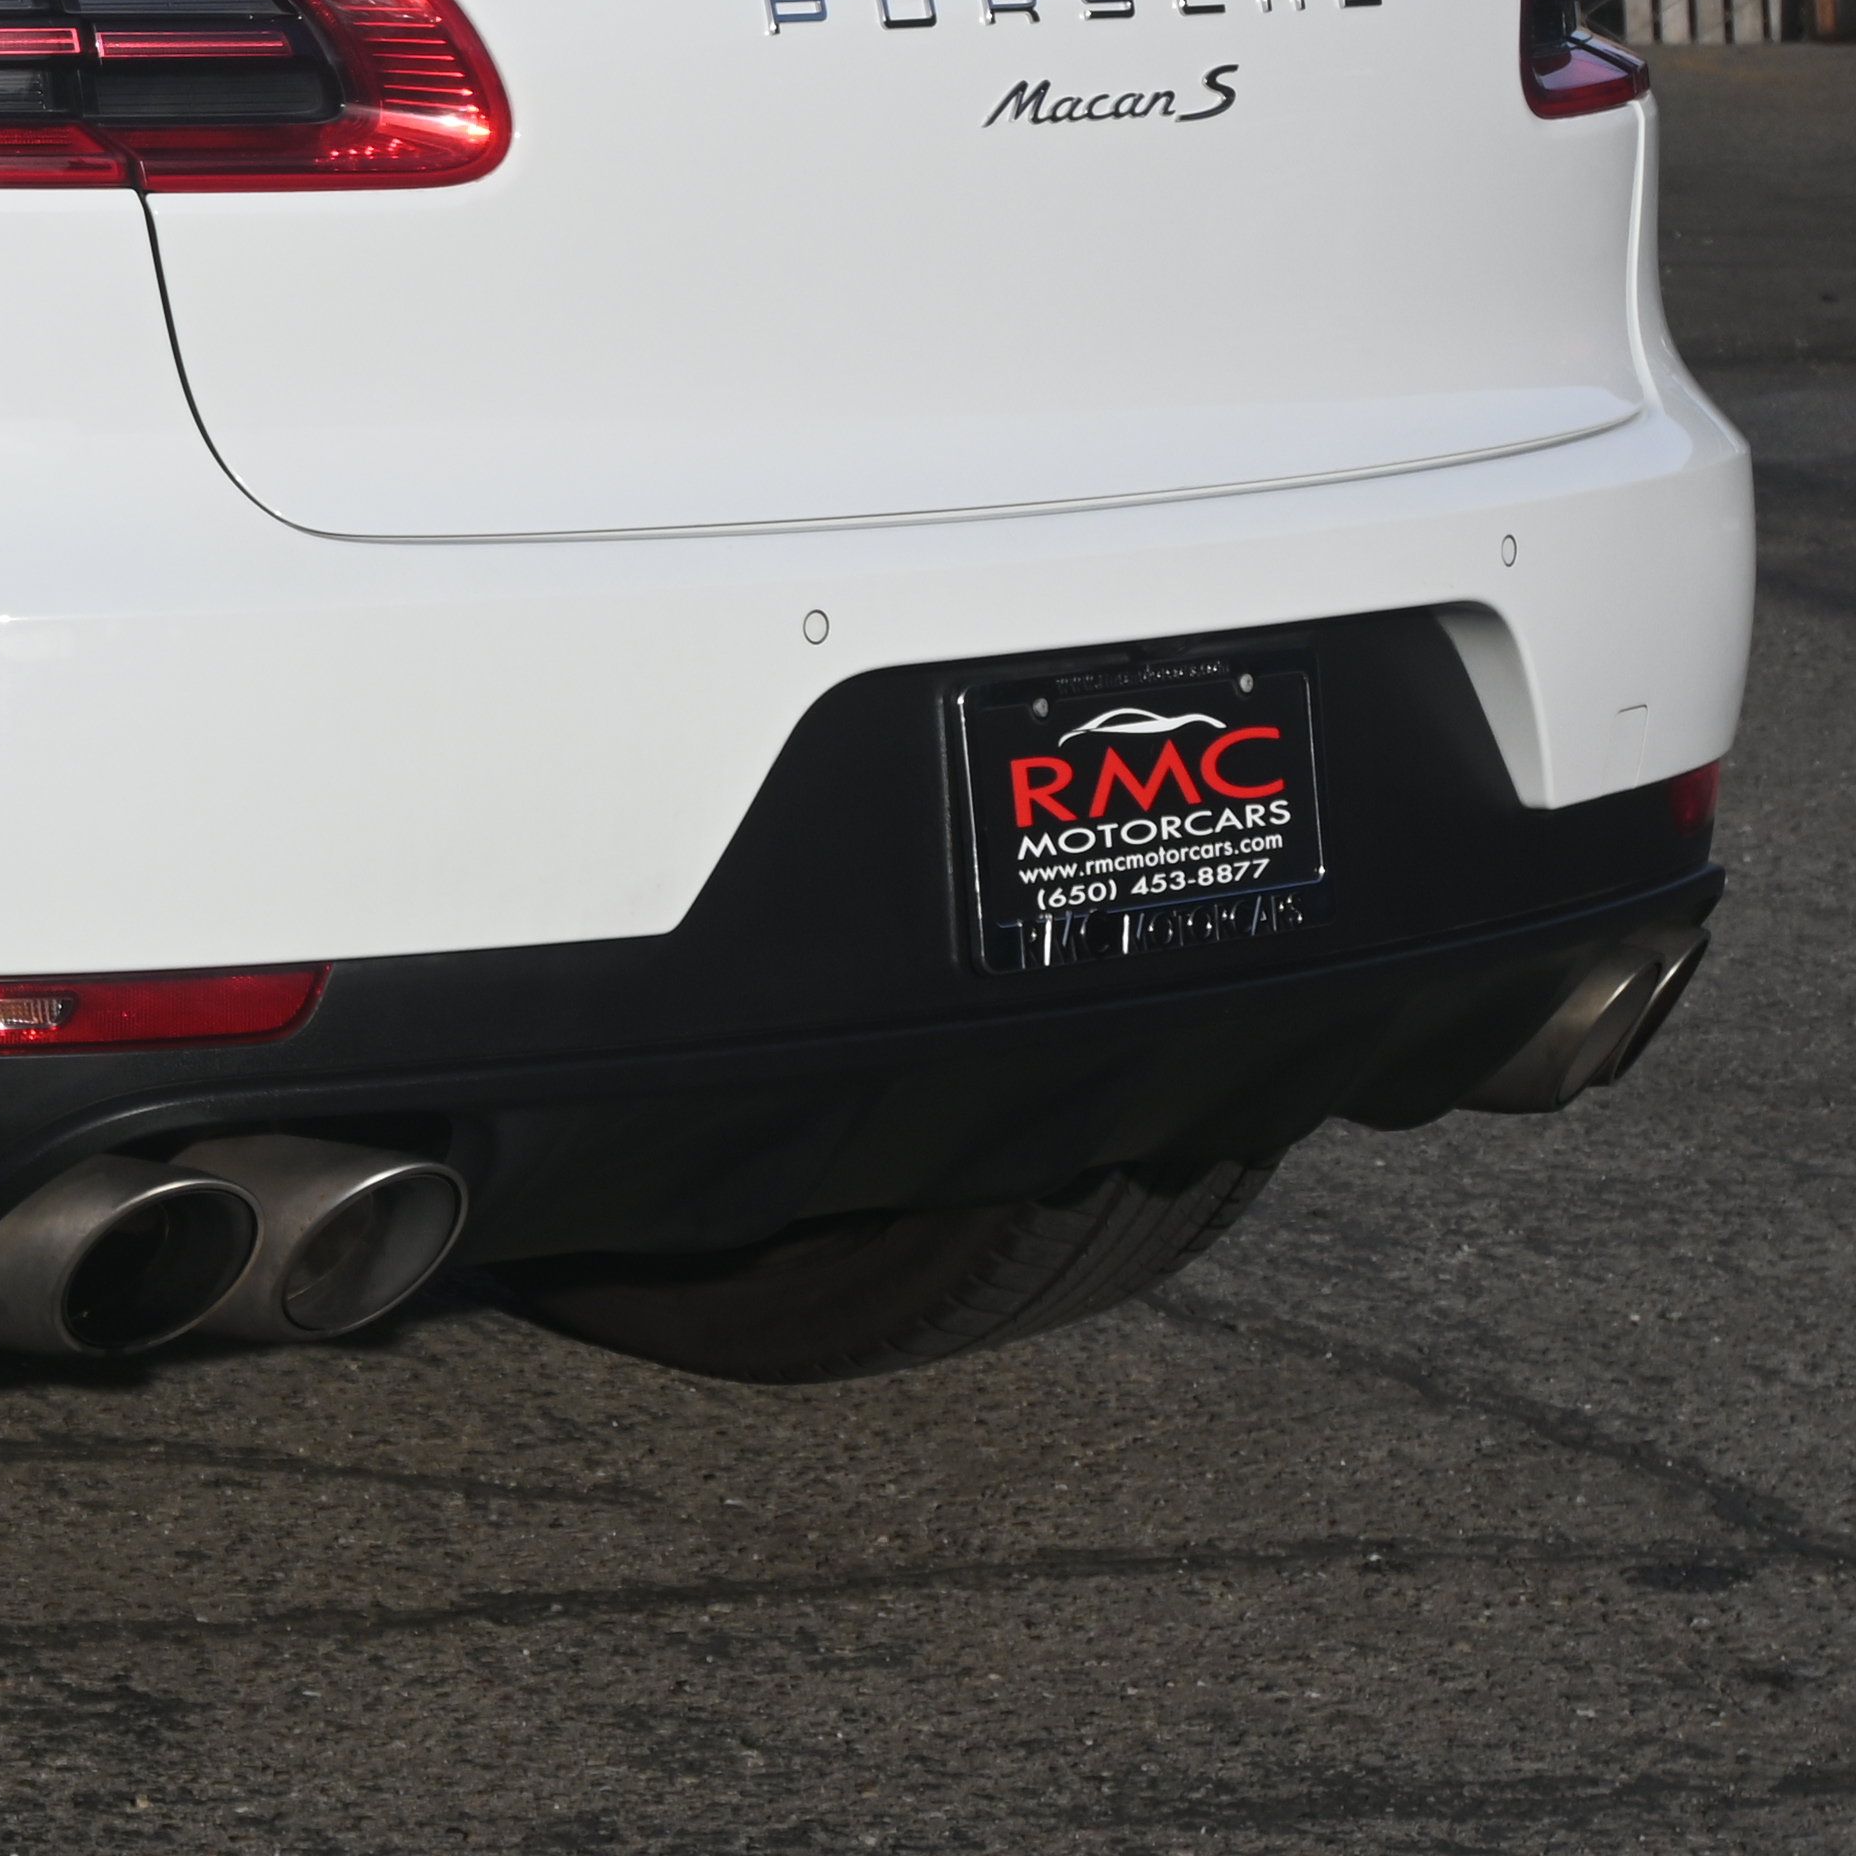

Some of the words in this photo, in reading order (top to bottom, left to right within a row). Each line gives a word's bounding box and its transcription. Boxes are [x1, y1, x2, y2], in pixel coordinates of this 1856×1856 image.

[981, 79, 1176, 129] Macan
[1174, 64, 1239, 123] S
[1010, 726, 1285, 828] RMC
[1017, 800, 1291, 861] MOTORCARS
[1018, 832, 1284, 885] www.rmcmotorcars.com
[1036, 878, 1117, 910] (650)
[1130, 858, 1271, 897] 453-8877
